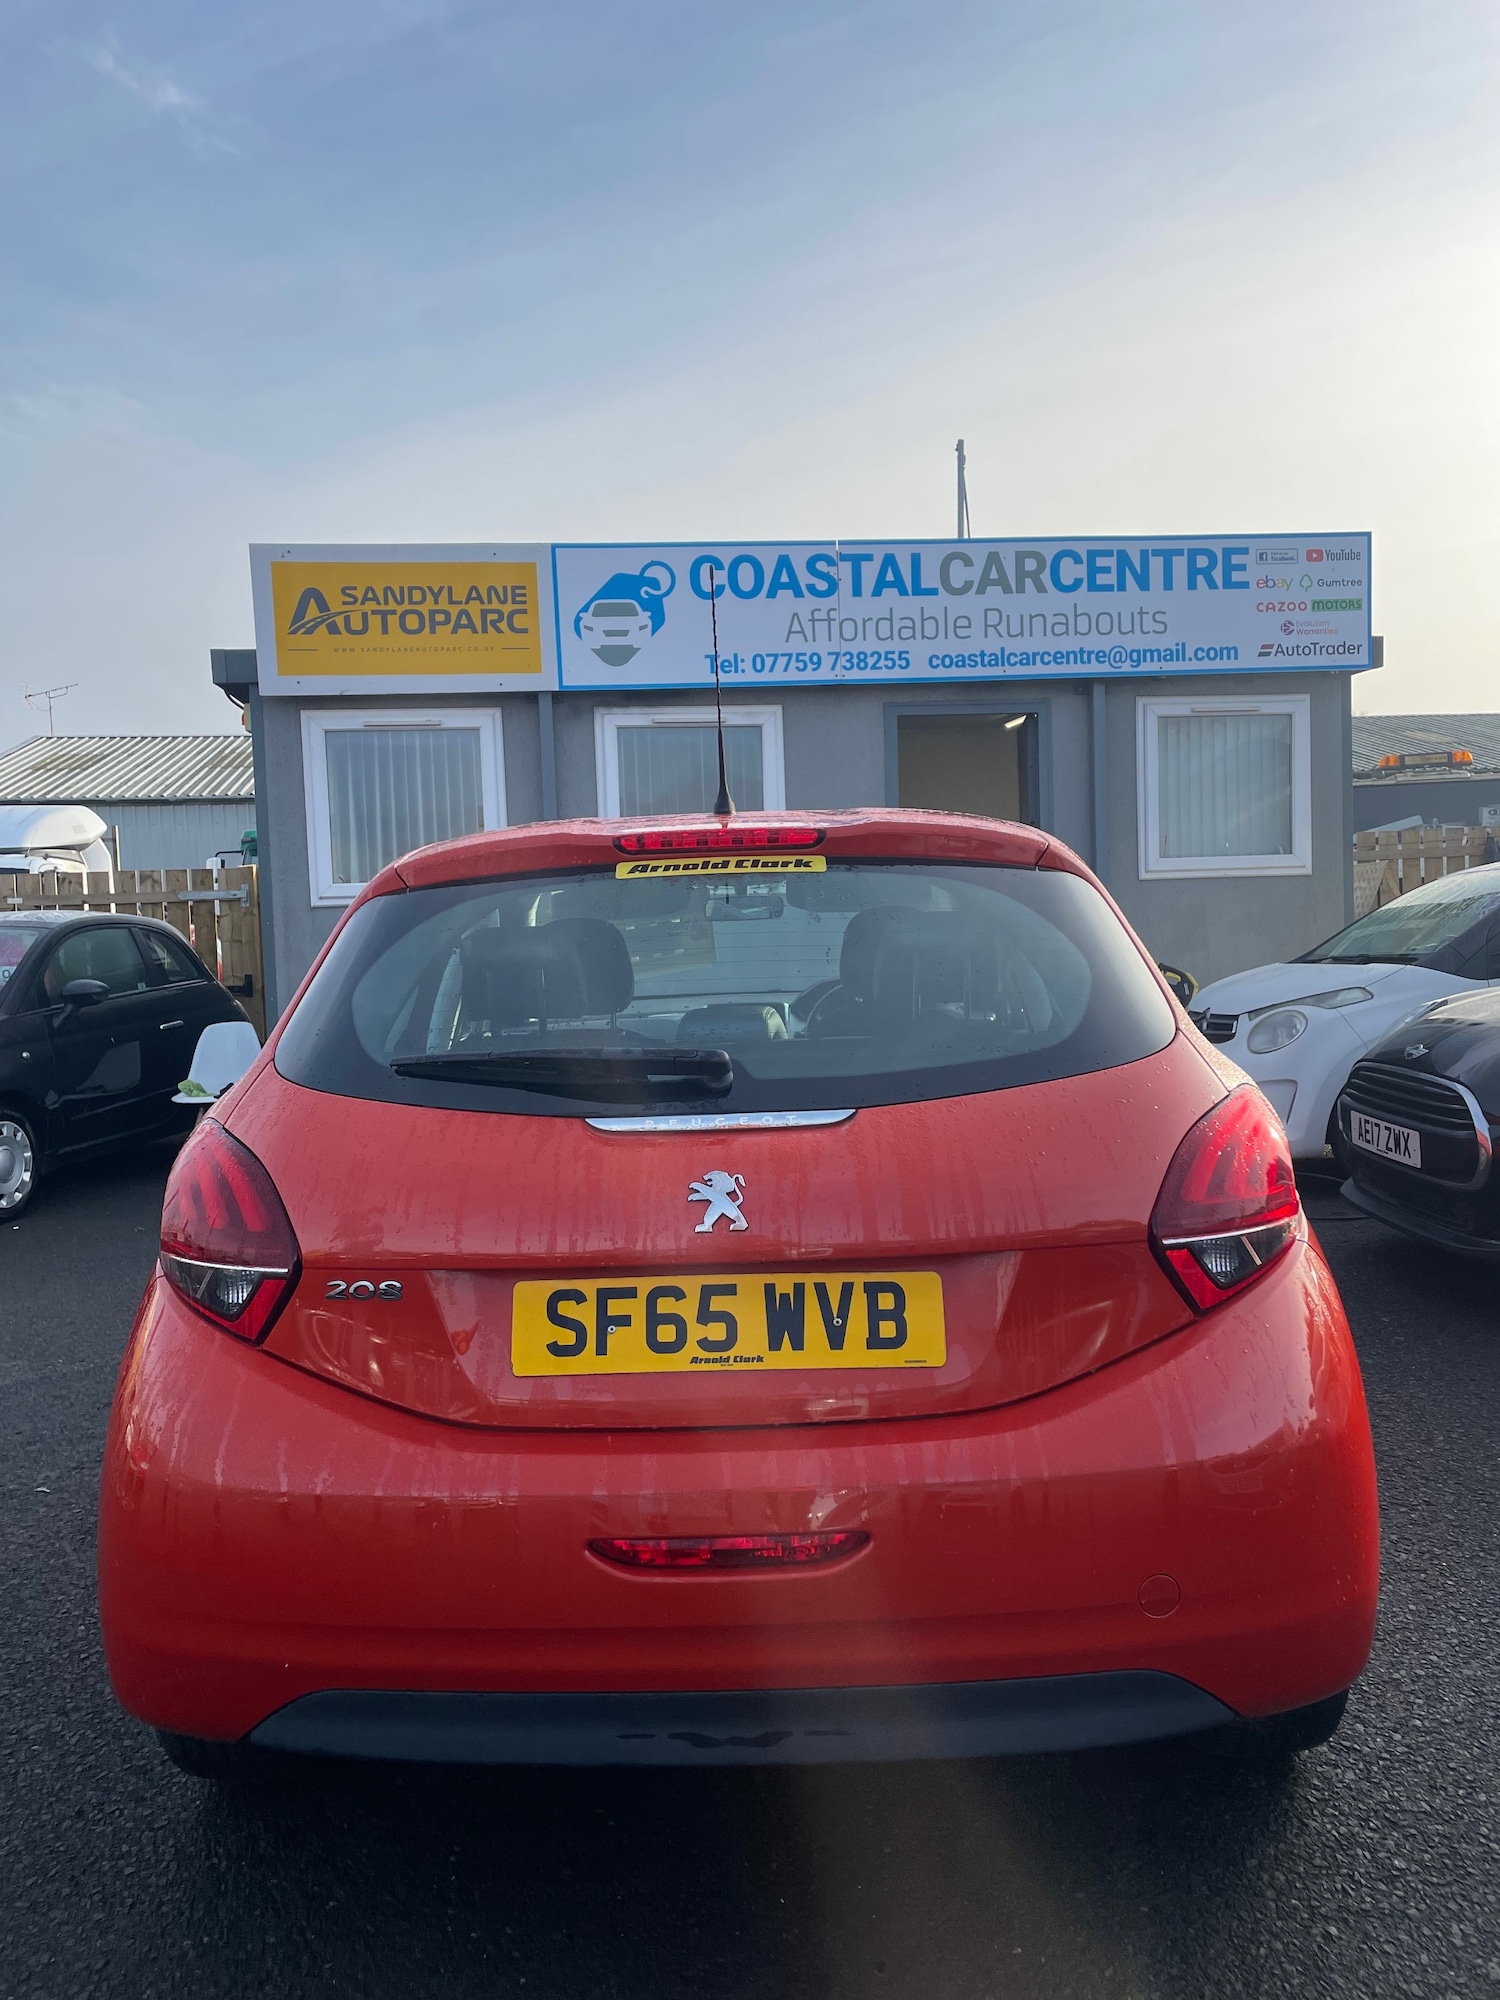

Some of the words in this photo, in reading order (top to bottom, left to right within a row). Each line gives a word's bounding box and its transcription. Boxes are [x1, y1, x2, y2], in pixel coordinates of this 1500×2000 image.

[1325, 548, 1361, 561] YouTube
[689, 547, 1250, 600] COASTALCARCENTRE
[1256, 575, 1293, 591] ebay
[1317, 578, 1363, 588] Gumtree
[340, 585, 528, 606] SANDYLANE
[286, 587, 530, 636] AUTOPARC
[1256, 601, 1308, 613] CAZOO
[1311, 599, 1362, 611] MOTORS
[785, 606, 972, 643] Affordable
[983, 603, 1168, 639] Runabouts
[1296, 620, 1330, 628] Evolution
[1296, 627, 1339, 635] Warranties
[1274, 641, 1363, 657] AutoTrader
[704, 653, 746, 675] Tel:
[751, 652, 822, 674] 07759
[827, 650, 911, 672] 738255
[928, 642, 1239, 669] coastalcarcentre@gmail.com
[626, 859, 731, 875] Arnold
[734, 858, 814, 870] Clark
[1358, 1117, 1381, 1147] AE17
[1384, 1126, 1411, 1158] ZWX
[325, 1280, 402, 1300] 208
[546, 1283, 738, 1358] SF65
[764, 1281, 908, 1352] WVB
[690, 1355, 730, 1364] Arnold
[733, 1354, 764, 1363] Clark
